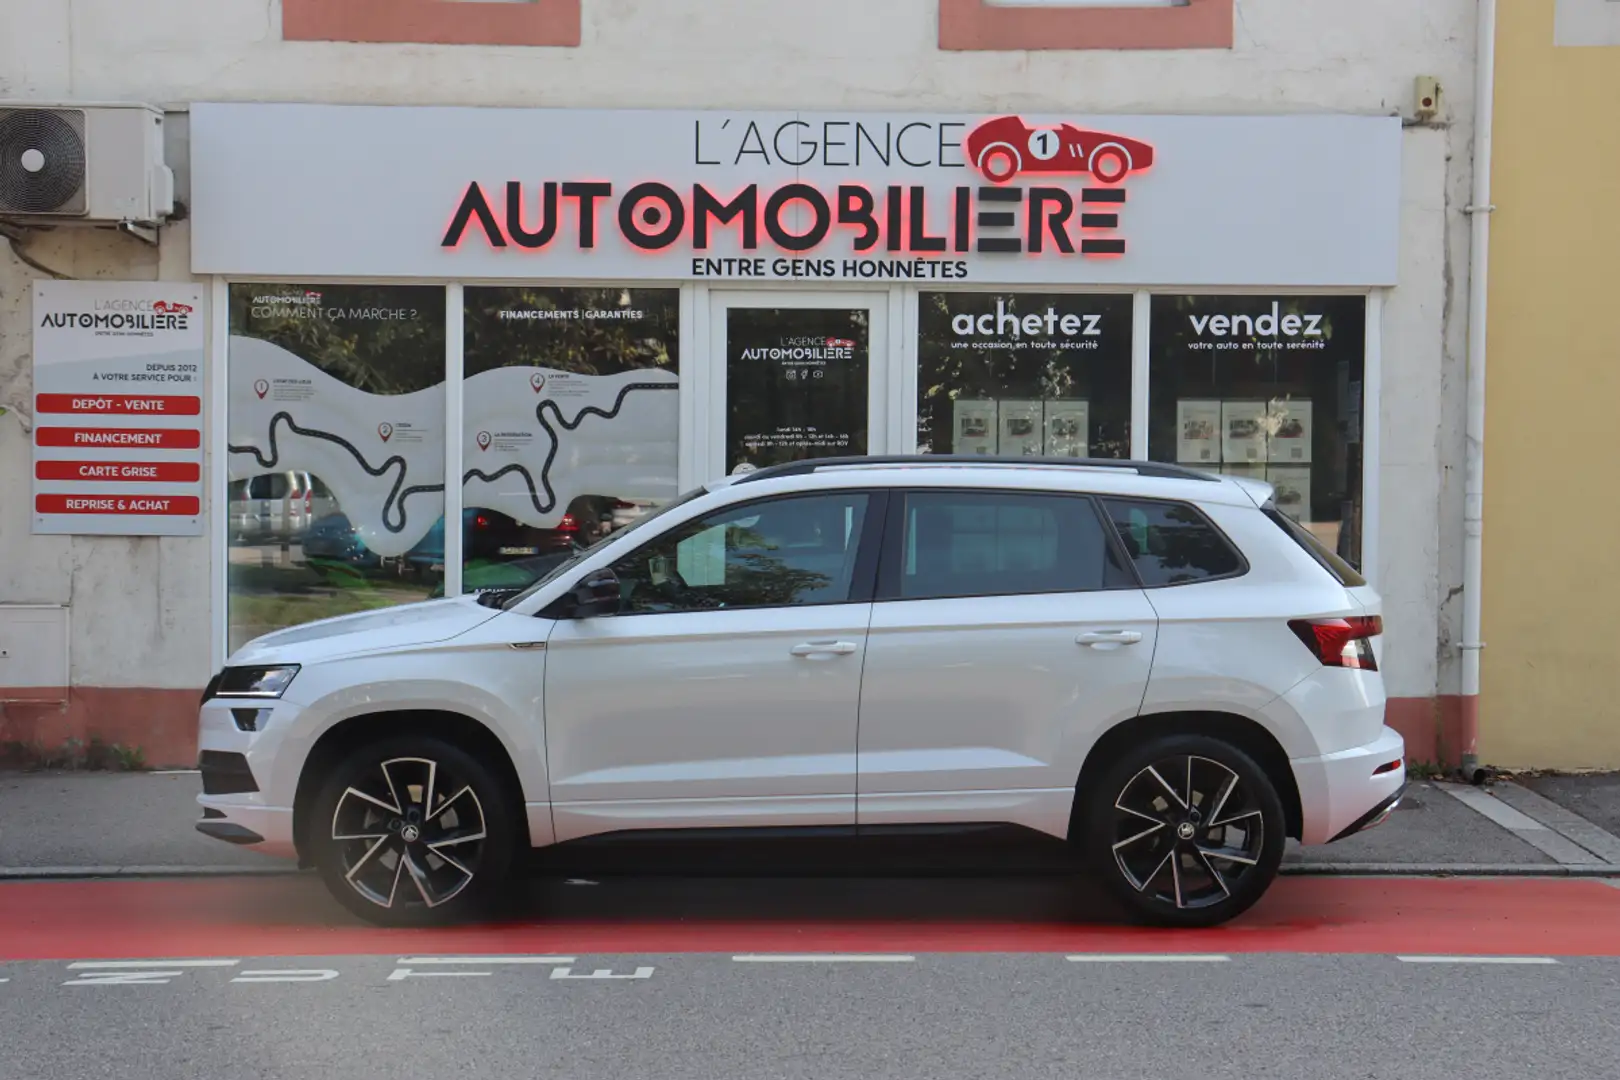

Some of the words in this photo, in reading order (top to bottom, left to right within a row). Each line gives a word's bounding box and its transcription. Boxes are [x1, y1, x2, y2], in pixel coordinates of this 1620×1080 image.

[693, 119, 966, 168] L'AGENCE
[1036, 133, 1048, 155] 1
[691, 258, 766, 277] ENTRE
[772, 258, 836, 278] GENS
[841, 256, 968, 279] HONNÊTES
[251, 306, 324, 319] COMMENT
[328, 307, 346, 321] ÇA
[349, 308, 407, 320] MARCHE
[409, 309, 417, 320] ?
[499, 310, 579, 319] FINANCEMENTS
[585, 310, 643, 319] GARANTIES
[951, 300, 1102, 336] achetez
[1188, 301, 1323, 336] vendez
[951, 341, 969, 349] une
[971, 340, 1013, 349] occasion
[1015, 341, 1028, 349] en
[1030, 341, 1057, 349] toute
[1059, 339, 1099, 349] sécurité
[1188, 341, 1213, 350] votre
[1216, 341, 1239, 350] auto
[1242, 342, 1254, 350] en
[1257, 341, 1283, 350] toute
[145, 363, 176, 372] DEPUIS
[177, 364, 197, 373] 2012
[101, 373, 129, 381] VOTRE
[131, 373, 165, 382] SERVICE
[167, 374, 191, 382] POUR
[125, 399, 165, 411] VENTE
[74, 432, 162, 444] FINANCEMENT
[79, 465, 119, 477] CARTE
[121, 466, 158, 478] GRISE
[65, 497, 115, 510] REPRISE
[117, 499, 126, 511] &
[128, 499, 171, 511] ACHAT
